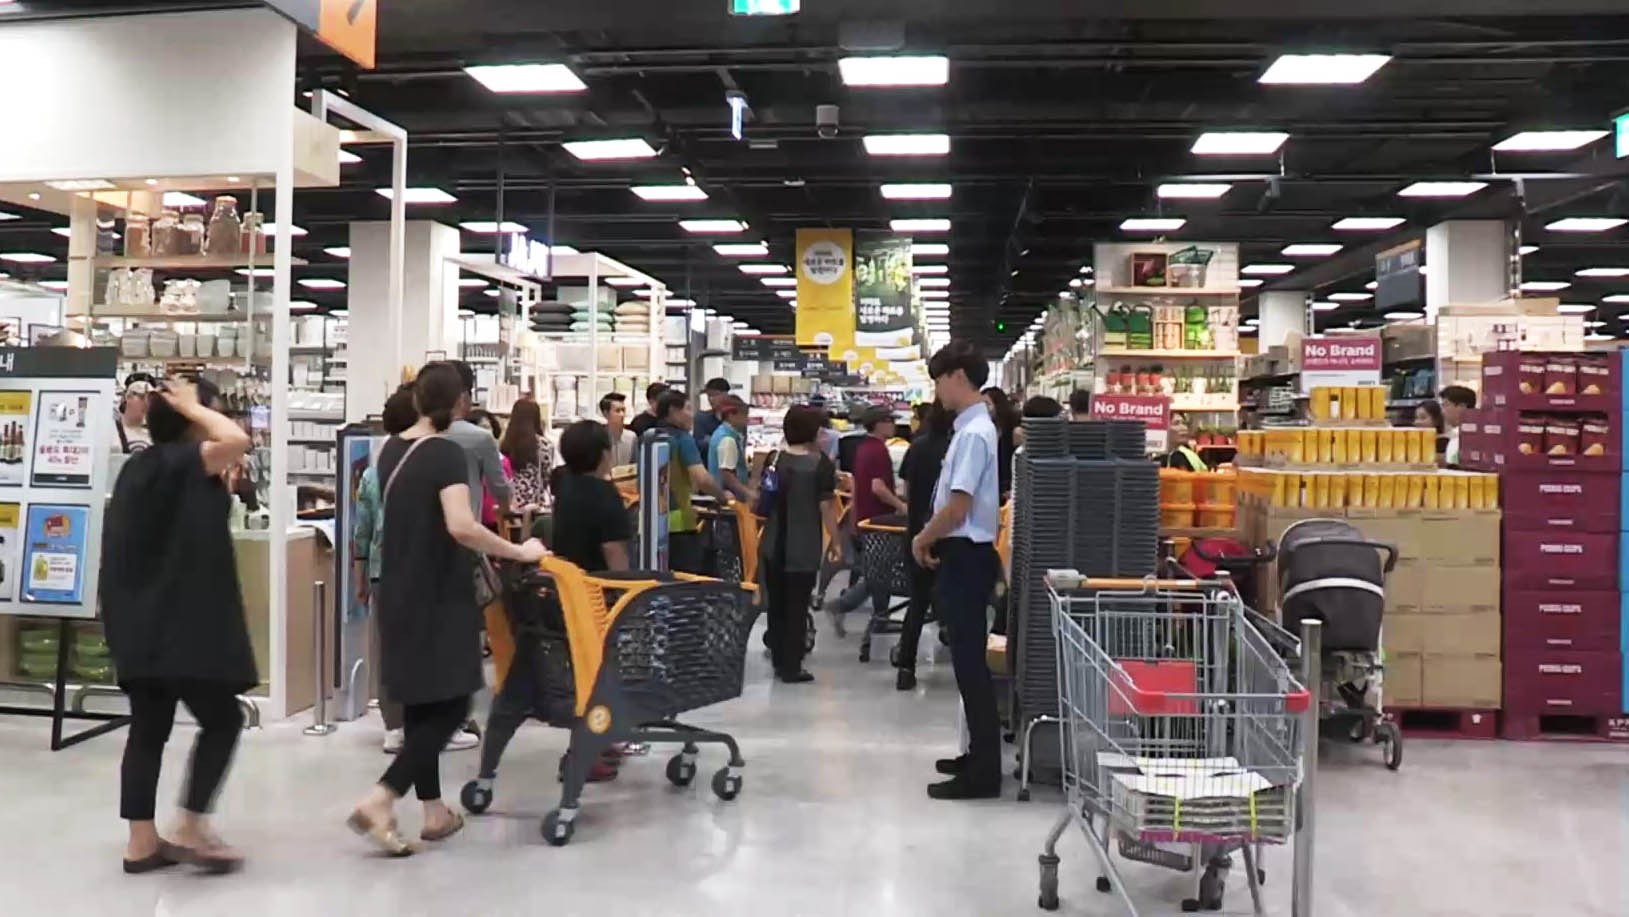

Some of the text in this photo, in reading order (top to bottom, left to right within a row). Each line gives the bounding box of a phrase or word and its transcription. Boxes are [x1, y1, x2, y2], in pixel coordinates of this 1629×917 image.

[1305, 344, 1374, 357] No Brand
[1094, 401, 1163, 416] No Brand
